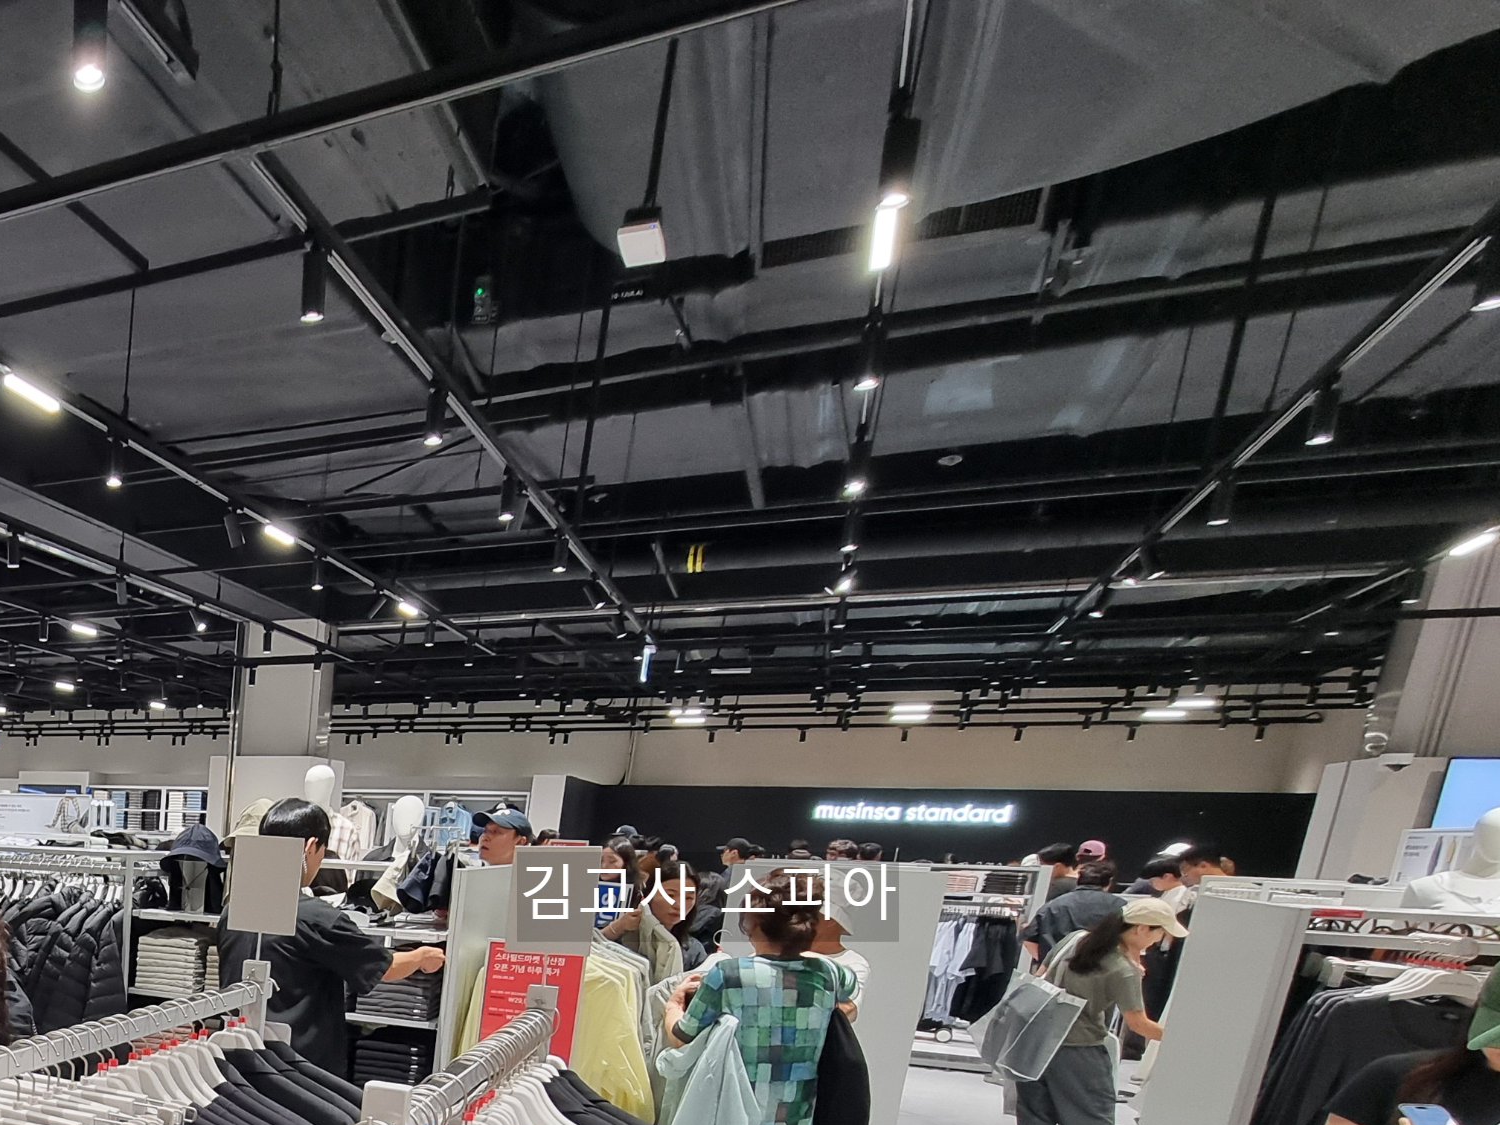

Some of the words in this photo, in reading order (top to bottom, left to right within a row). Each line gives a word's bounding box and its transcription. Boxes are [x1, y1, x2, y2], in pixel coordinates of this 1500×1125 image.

[813, 801, 902, 821] musinsa
[904, 803, 1015, 824] standard
[494, 952, 540, 964] 스타필드마켓
[493, 963, 508, 973] 오픈
[510, 965, 525, 974] 기념
